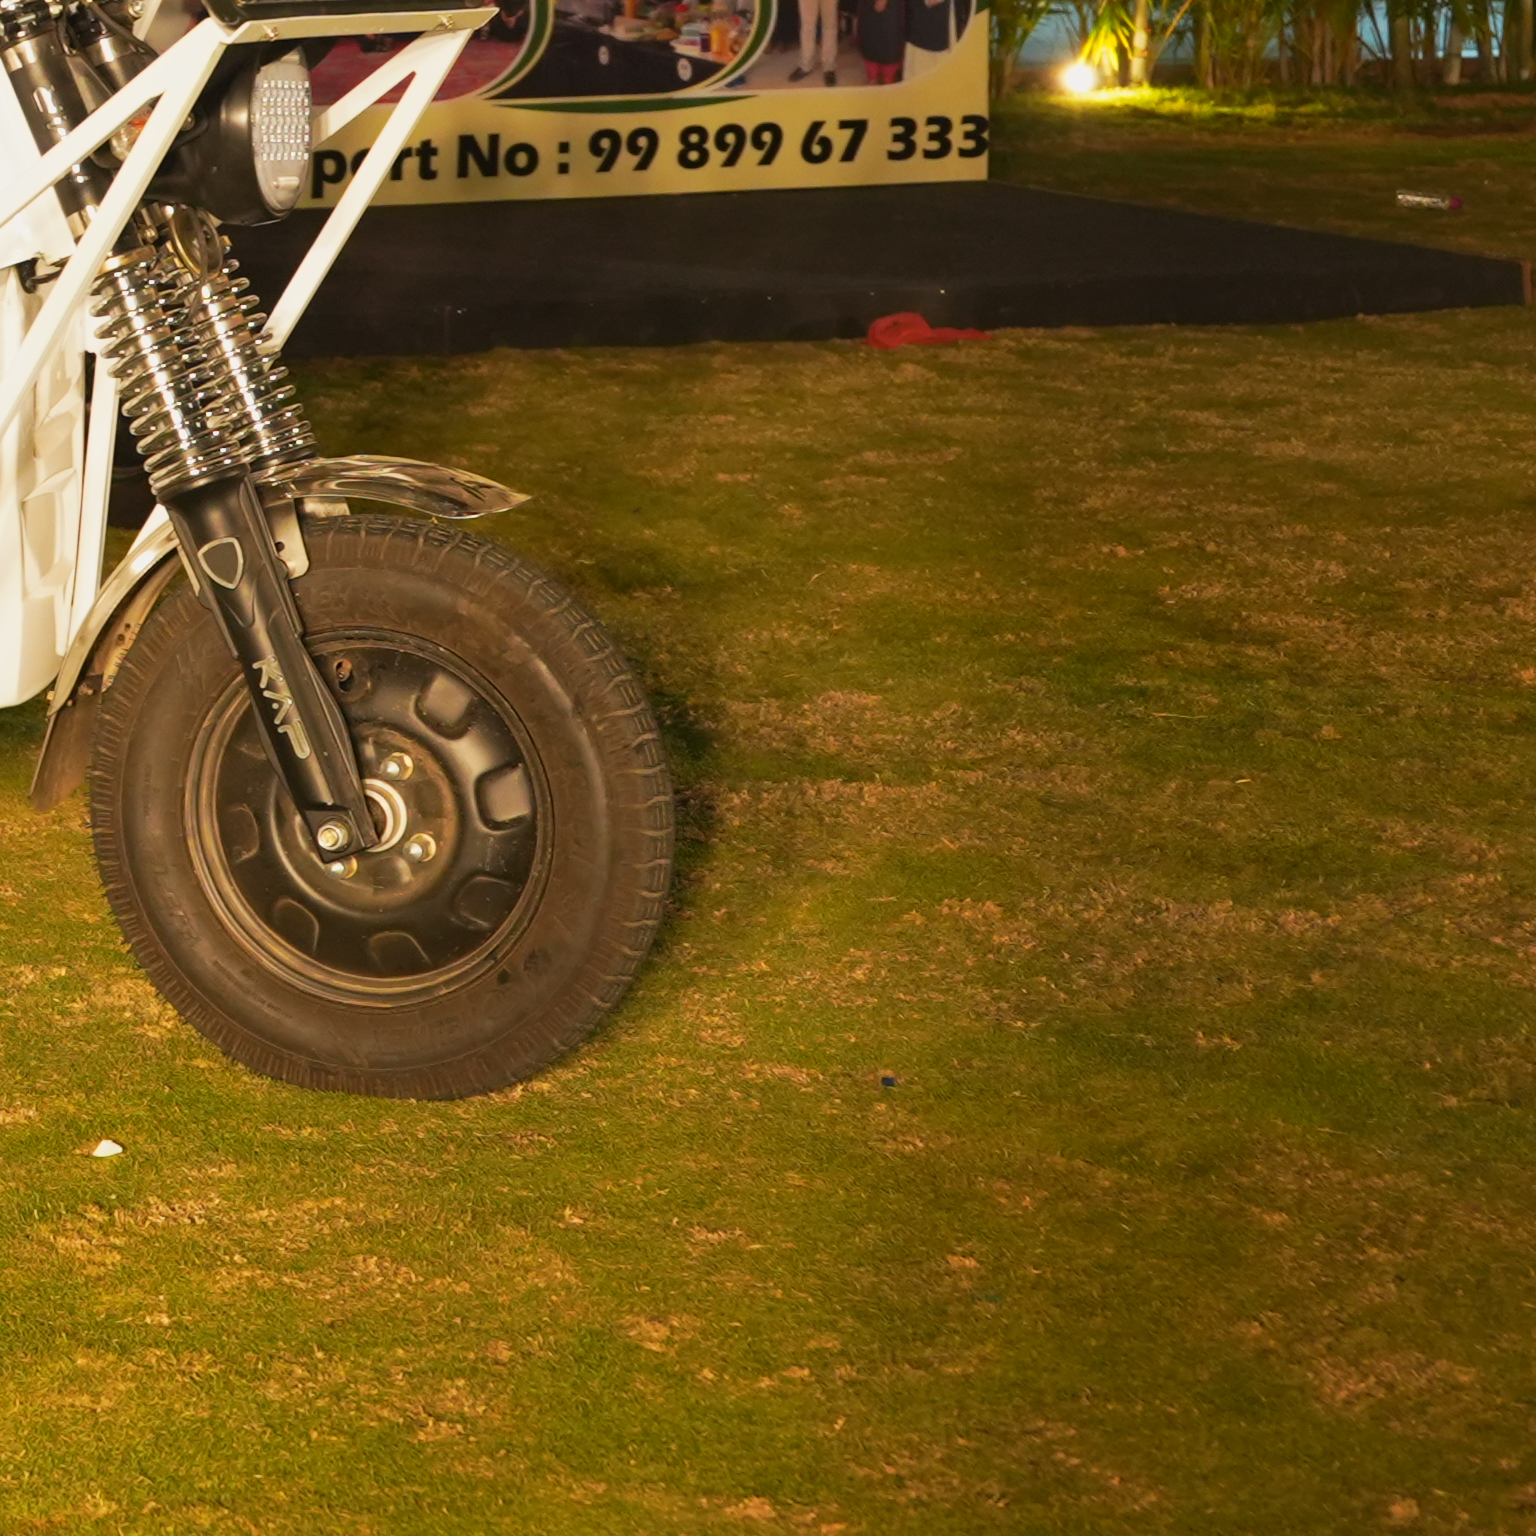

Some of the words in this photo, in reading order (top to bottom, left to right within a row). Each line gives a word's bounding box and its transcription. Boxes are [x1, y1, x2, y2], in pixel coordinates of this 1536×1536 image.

[456, 132, 540, 179] No
[588, 126, 661, 172] 99
[676, 121, 785, 170] 899
[799, 118, 870, 164] 67
[885, 114, 990, 162] 333
